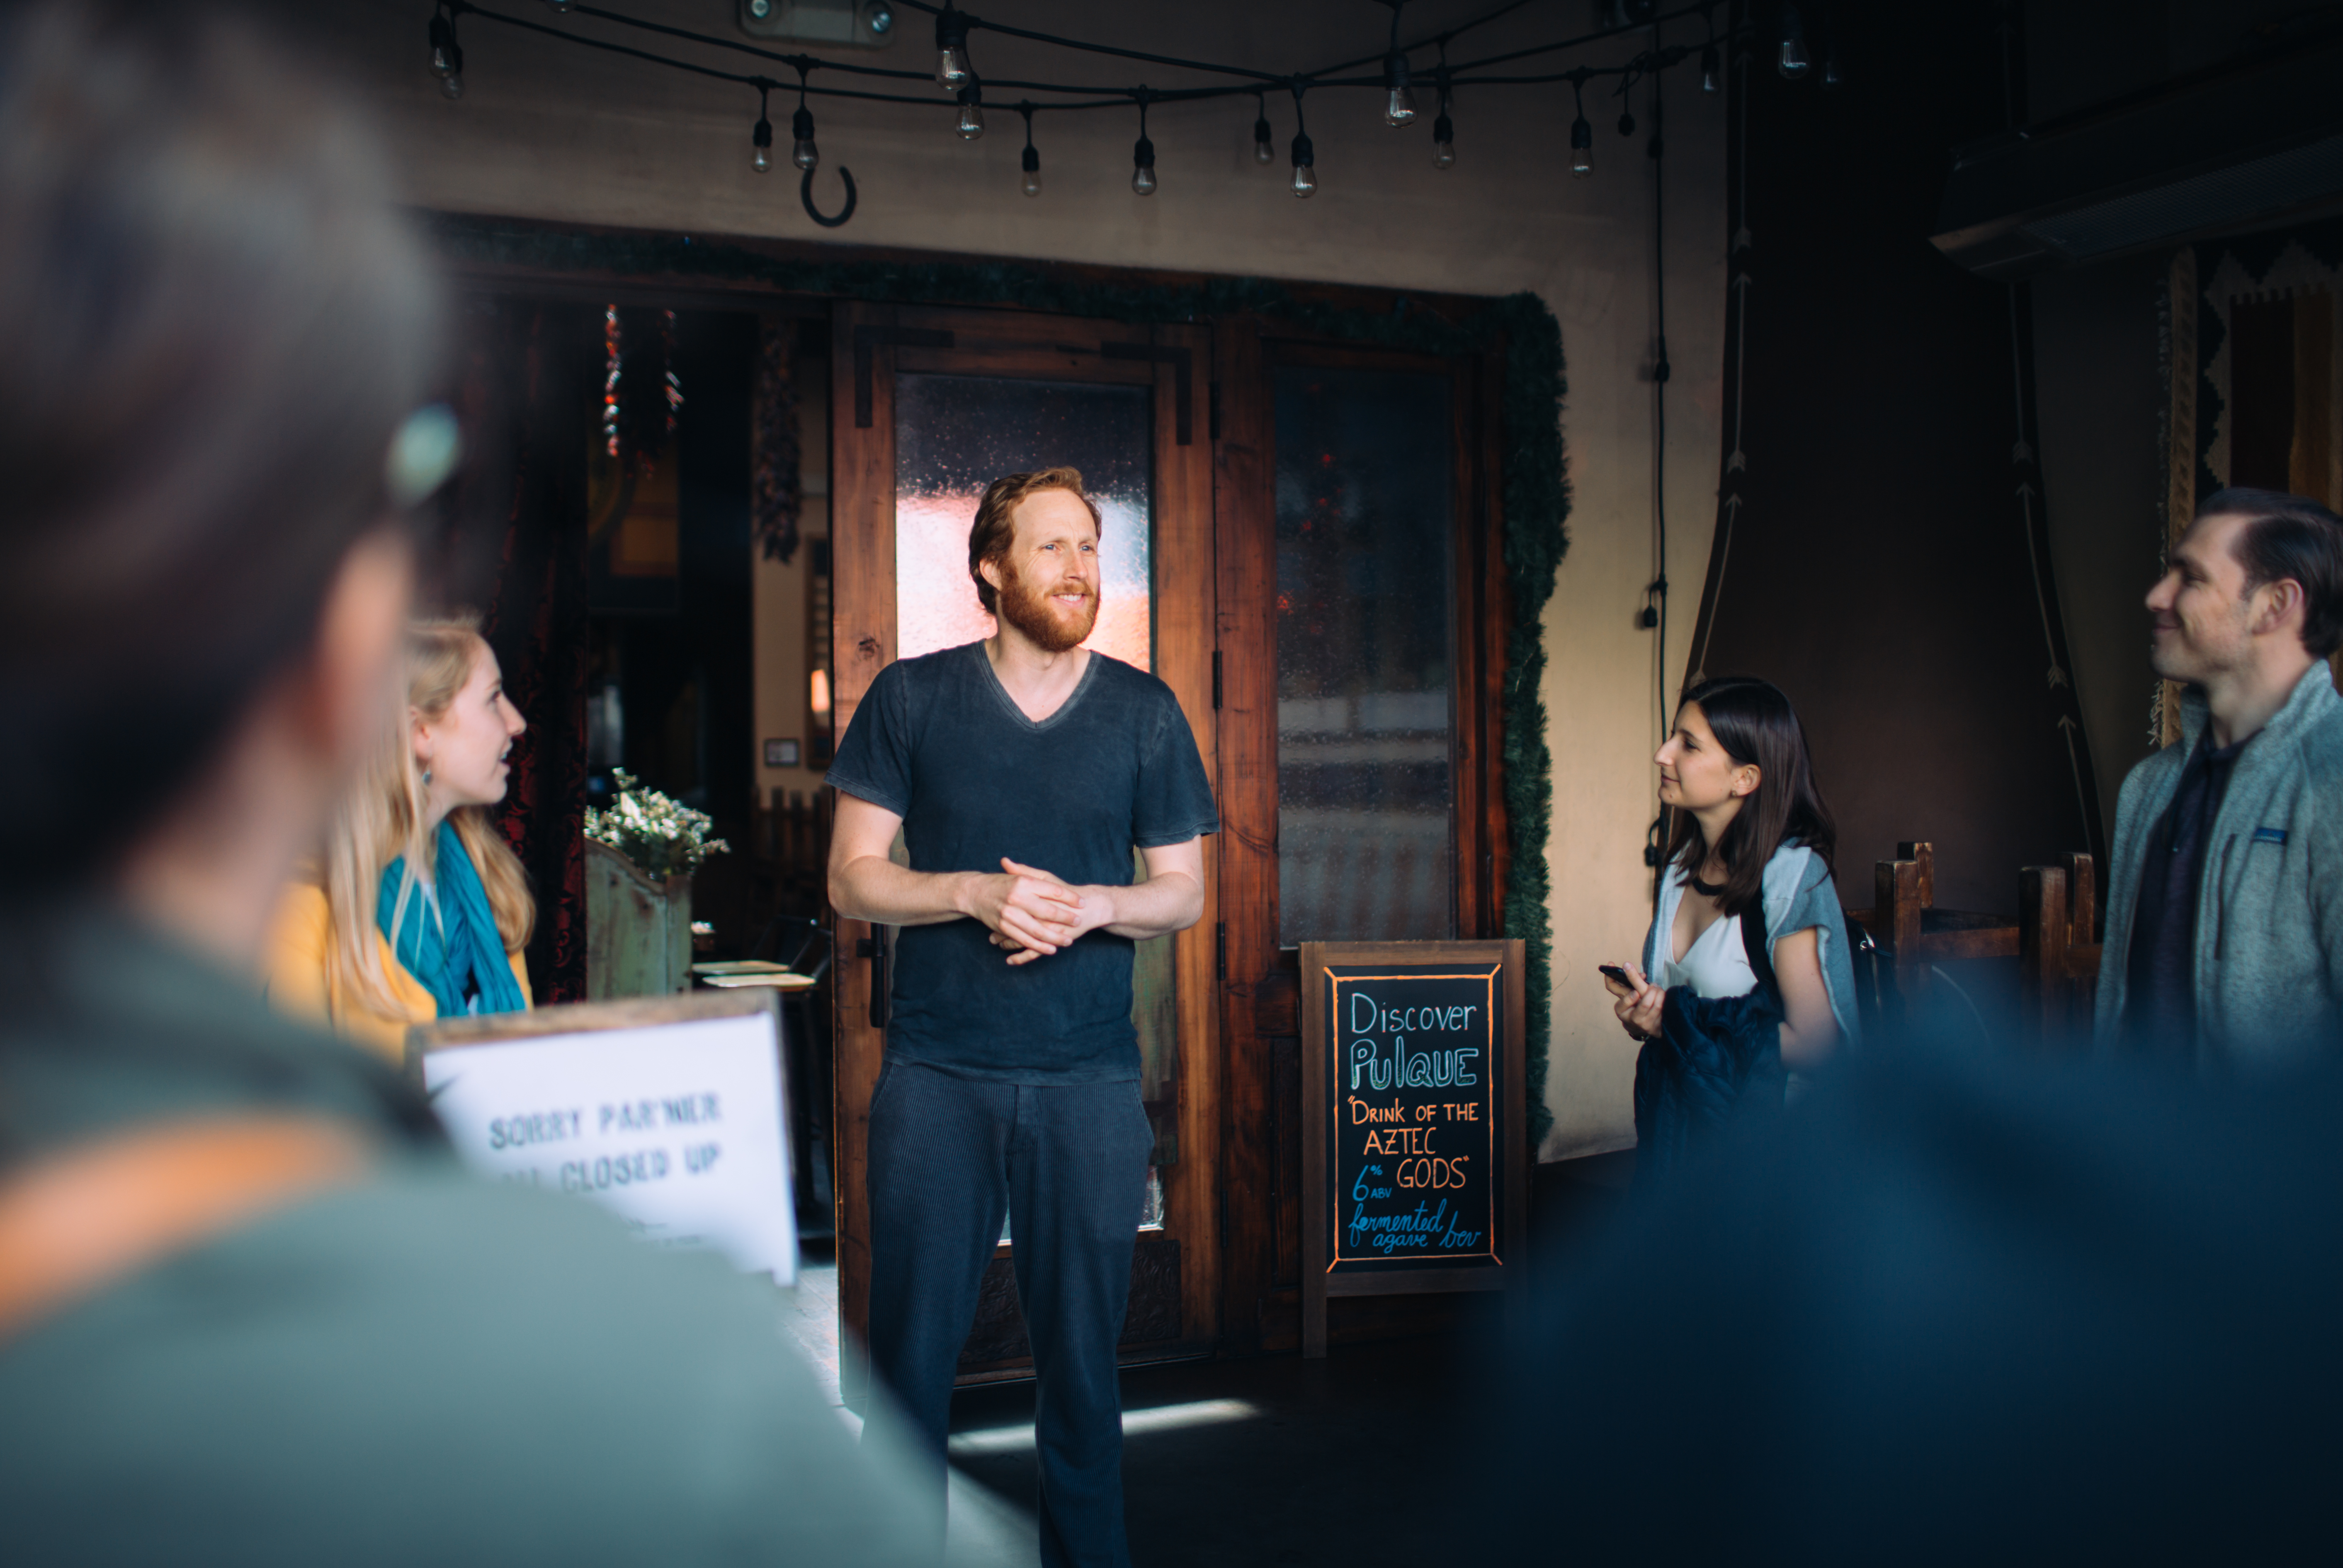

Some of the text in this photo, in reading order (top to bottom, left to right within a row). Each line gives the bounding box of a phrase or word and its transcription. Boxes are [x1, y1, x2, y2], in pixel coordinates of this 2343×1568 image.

[1351, 993, 1477, 1034] Discover
[1416, 1105, 1437, 1121] OF
[1443, 1102, 1479, 1121] THE
[490, 1108, 582, 1150] SORRY
[1363, 1127, 1437, 1155] AZTEC
[560, 1148, 669, 1197] CLOSED
[685, 1143, 720, 1176] UP
[1370, 1187, 1392, 1199] ABV
[1348, 1198, 1447, 1248] fermented
[1372, 1233, 1428, 1254] agave
